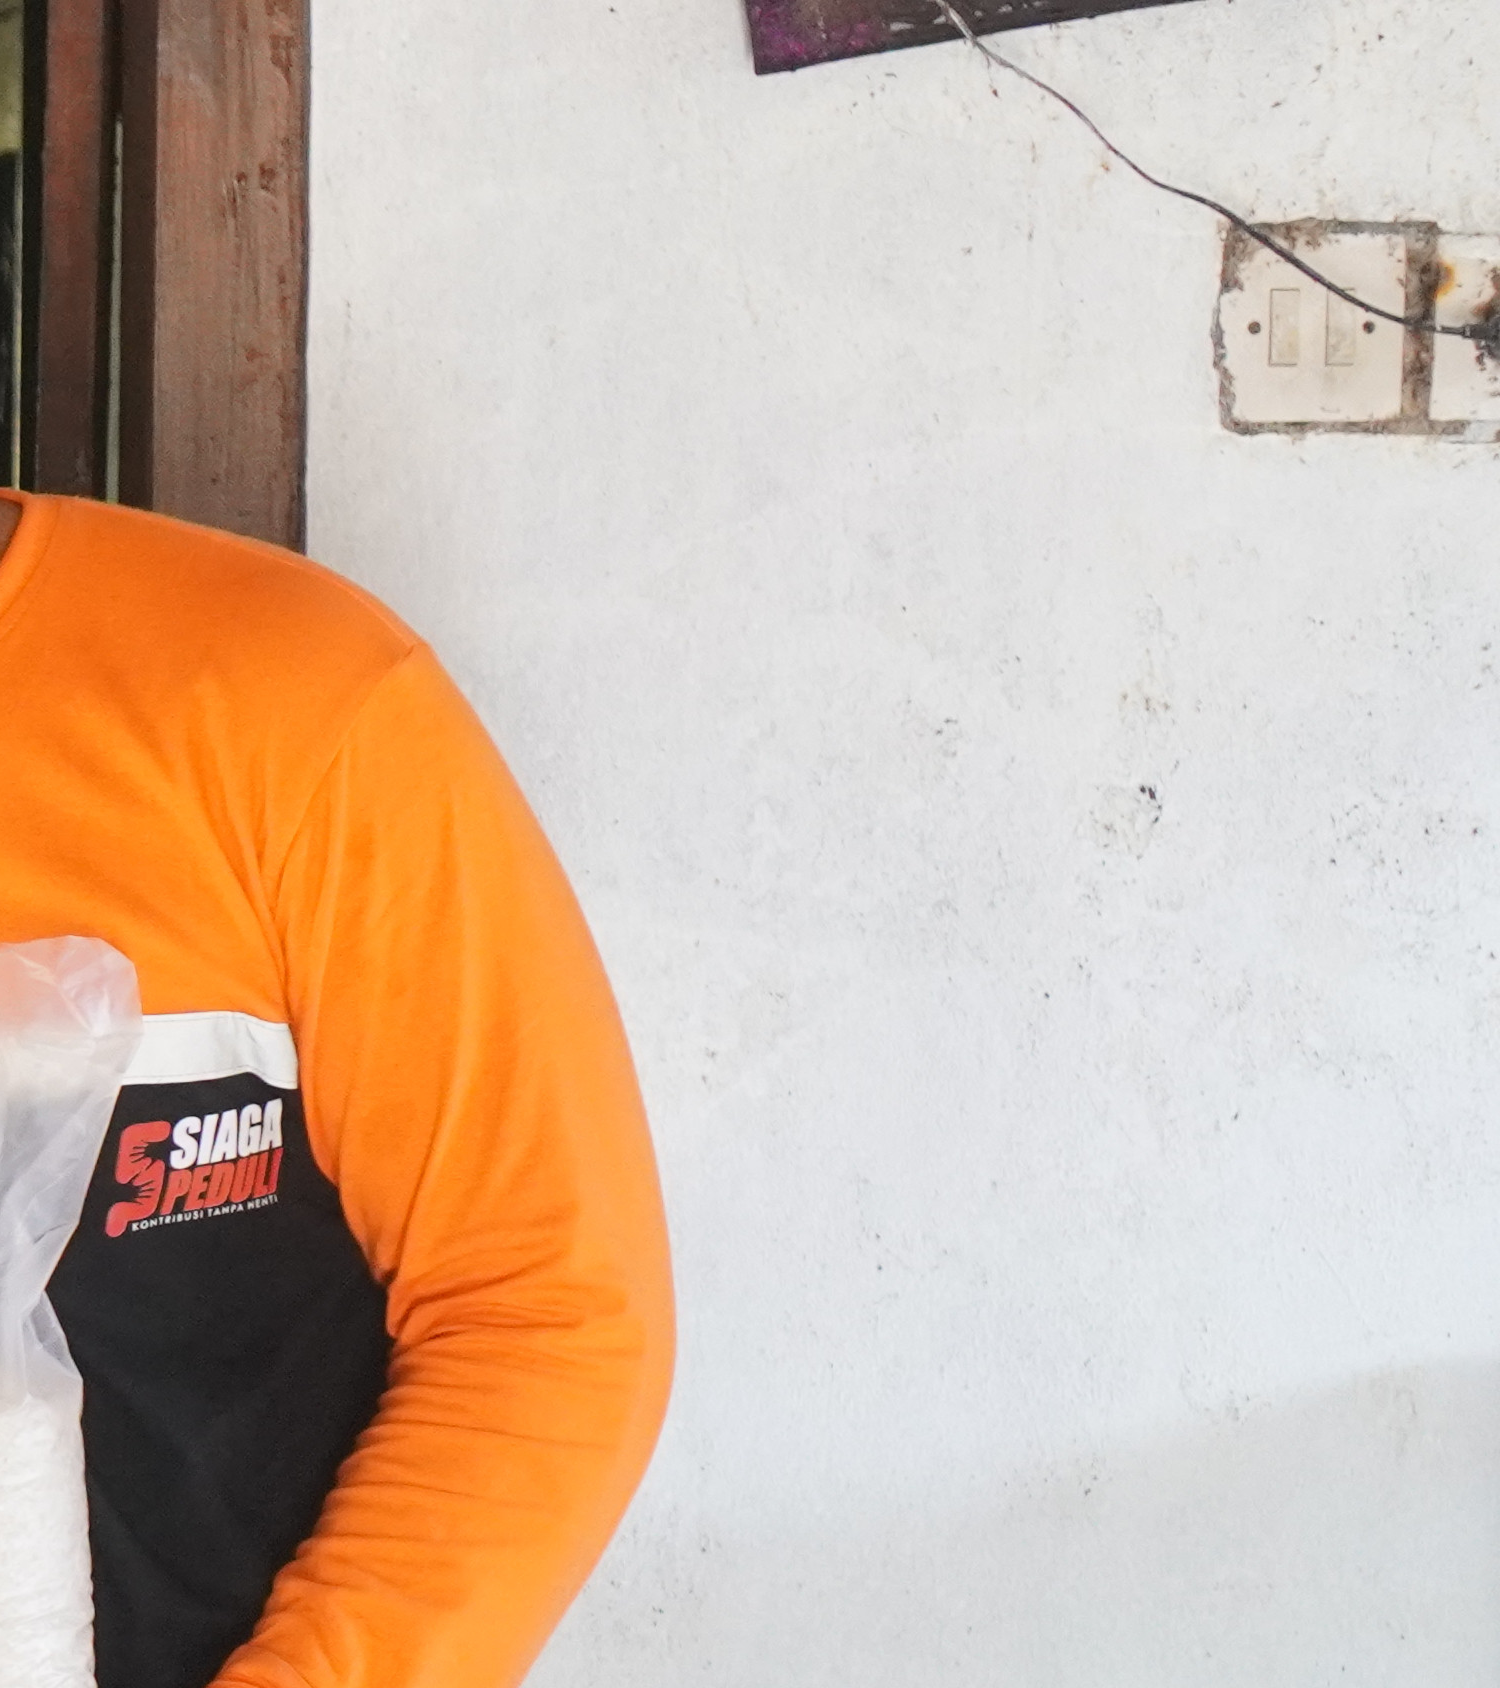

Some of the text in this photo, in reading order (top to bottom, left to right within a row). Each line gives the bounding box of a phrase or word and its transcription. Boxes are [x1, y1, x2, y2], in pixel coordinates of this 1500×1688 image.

[170, 1099, 283, 1169] SIAGA
[132, 1195, 278, 1232] KONTRIBUSI TANPA HENTI
[160, 1148, 284, 1215] PEDULI
